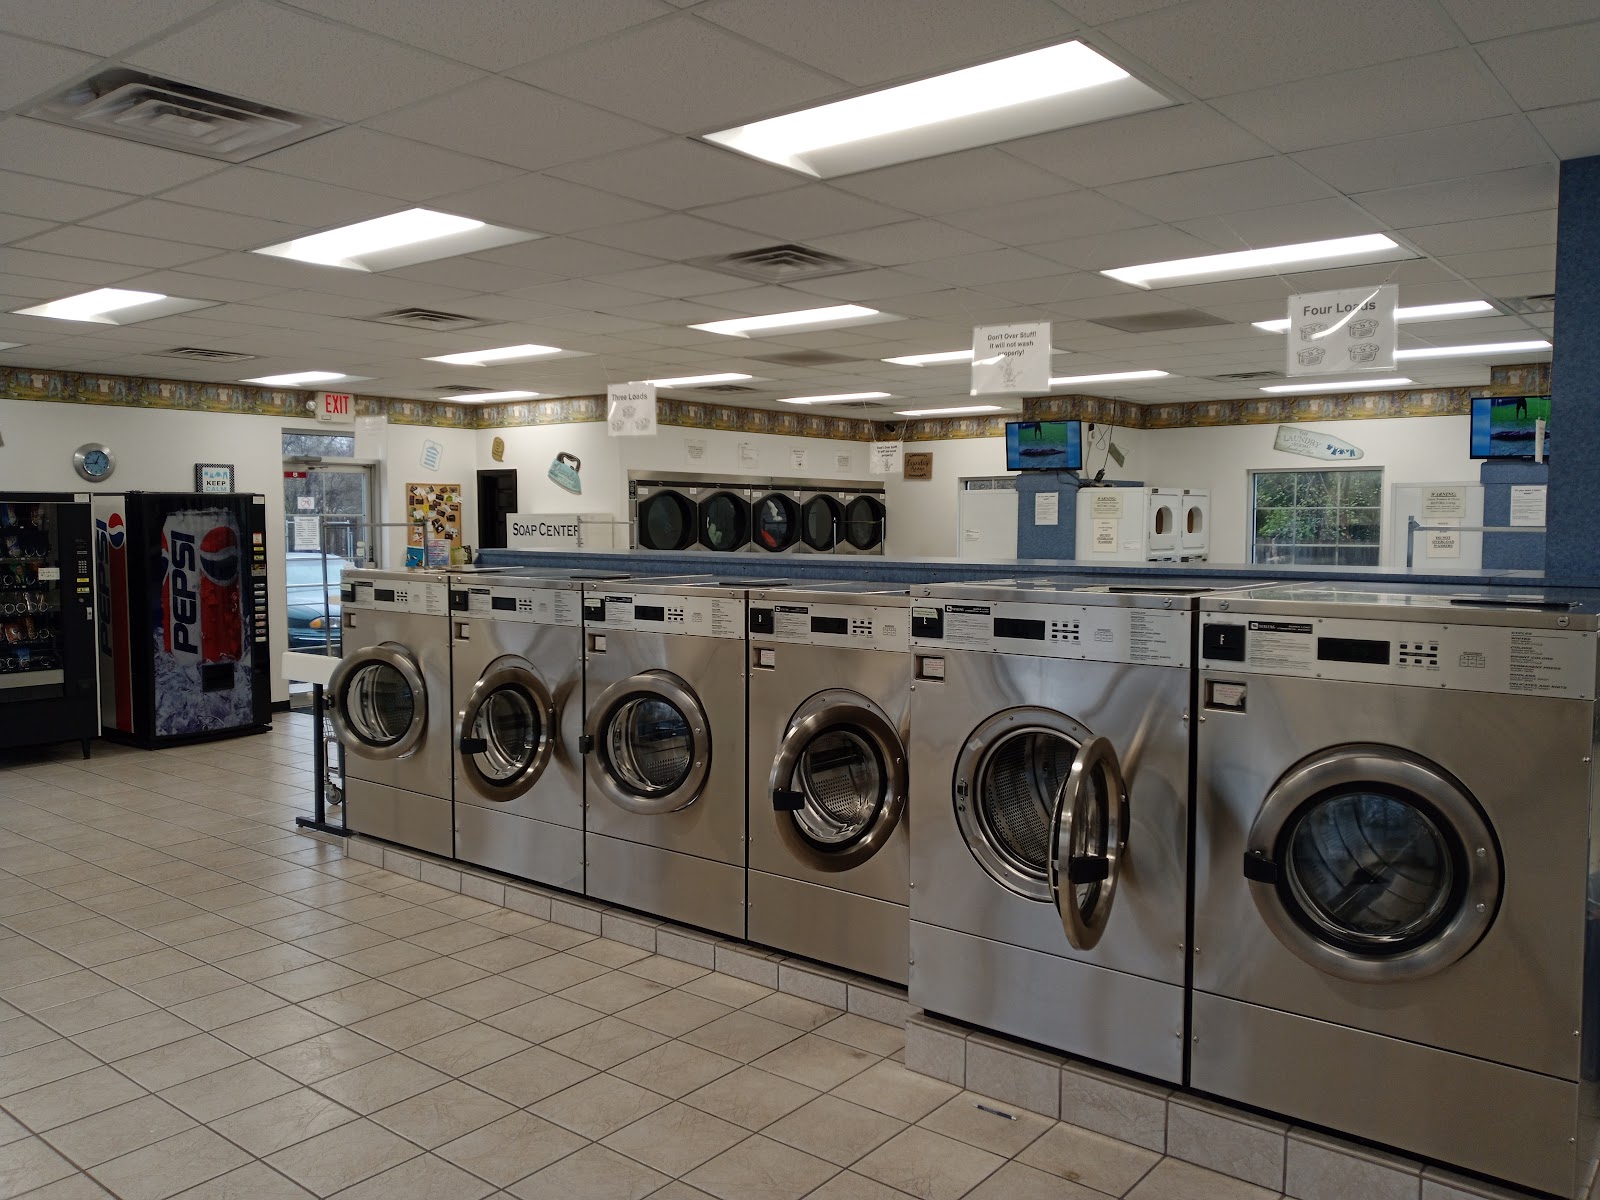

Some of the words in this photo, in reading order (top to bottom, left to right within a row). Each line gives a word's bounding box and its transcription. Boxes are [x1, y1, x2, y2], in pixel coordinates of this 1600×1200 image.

[1303, 305, 1332, 316] Four
[628, 392, 647, 400] Loads
[325, 394, 349, 414] EXIT
[1283, 435, 1322, 448] LAUNDRY
[513, 522, 537, 536] SOAP
[539, 522, 578, 537] CENTER
[95, 518, 112, 657] PEPSI
[171, 530, 198, 655] PEPSI
[1219, 634, 1225, 645] F
